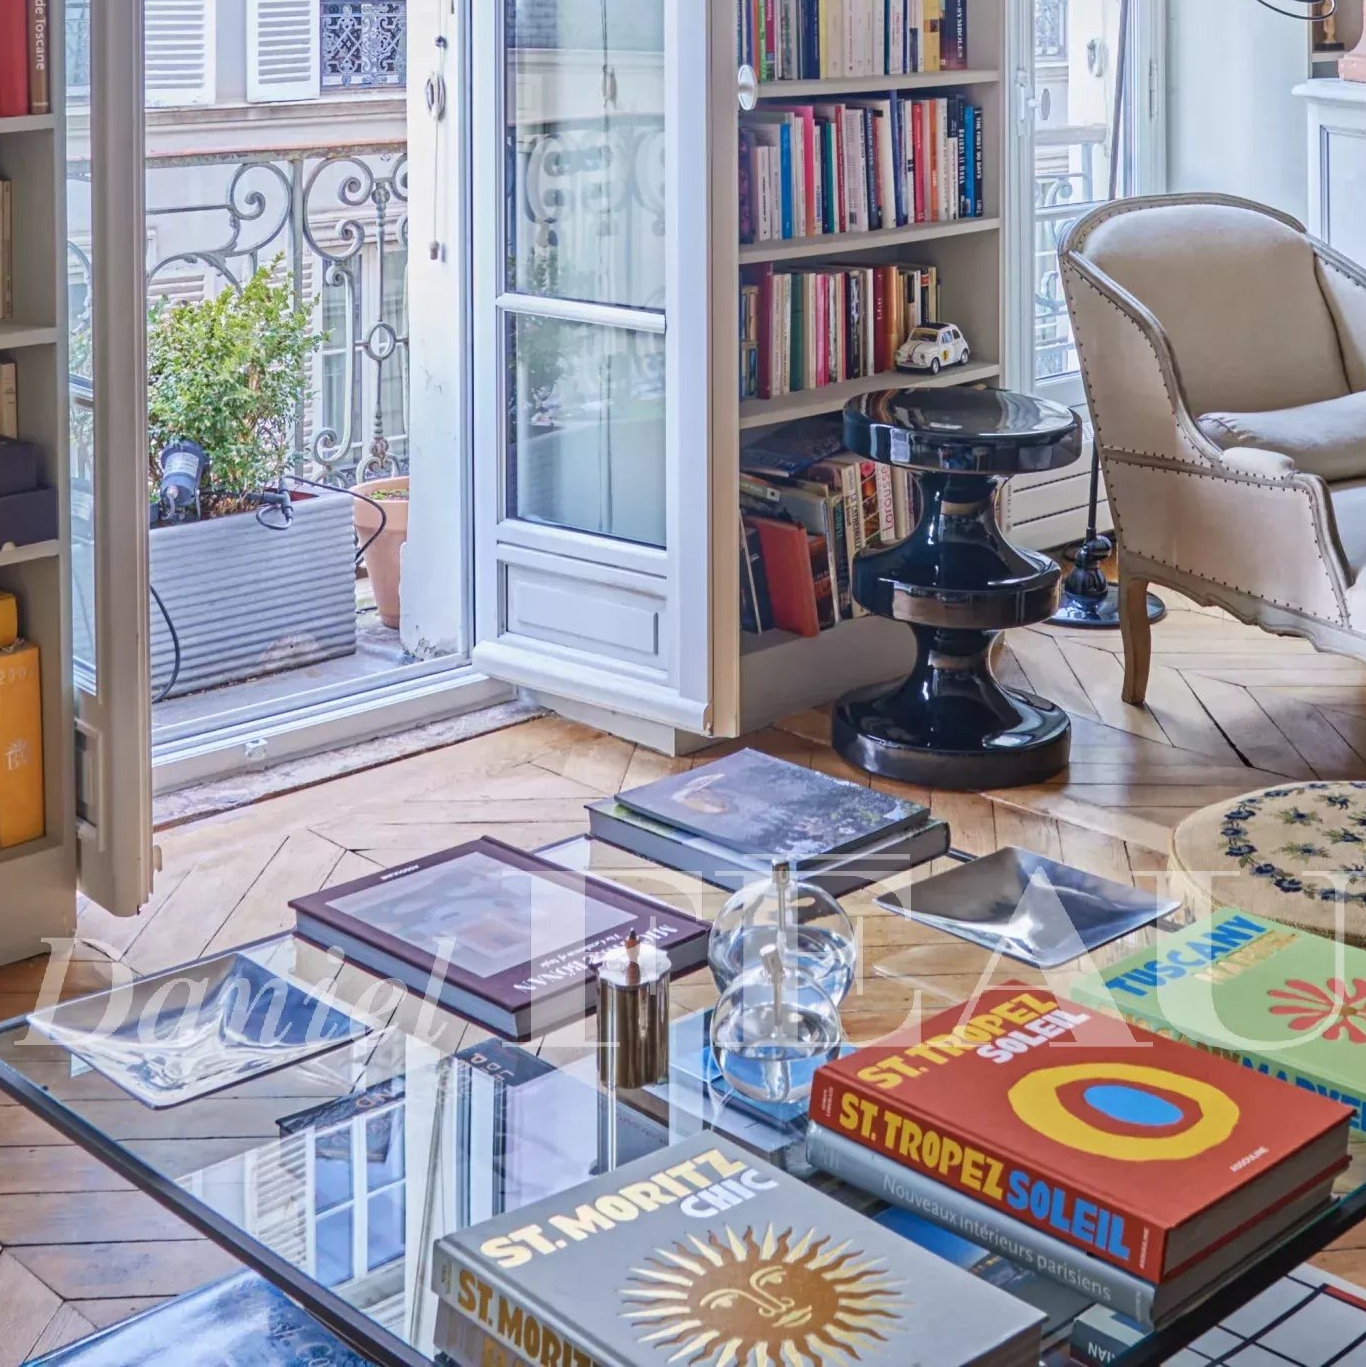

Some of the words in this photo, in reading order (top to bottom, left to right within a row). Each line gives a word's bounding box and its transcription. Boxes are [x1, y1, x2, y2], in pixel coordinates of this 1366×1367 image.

[35, 17, 47, 70] Toscane
[976, 151, 982, 161] 90
[1105, 914, 1269, 997] TUSCANY
[856, 1056, 930, 1090] ST.
[905, 992, 1059, 1065] TROPEZ
[976, 1008, 1091, 1065] SOLEIL
[838, 1091, 880, 1142] ST.
[883, 1109, 1005, 1201] TROPEZ
[1006, 1169, 1131, 1262] SOLEIL
[1229, 1146, 1270, 1172] ASSOULINE
[480, 1222, 569, 1270] ST.
[548, 1146, 750, 1243] MORITZ
[679, 1167, 781, 1219] CHIC
[883, 1176, 958, 1225] Nouveaux
[960, 1211, 1034, 1262] intérieurs
[1036, 1252, 1113, 1301] parisiens
[457, 1268, 494, 1329] ST.
